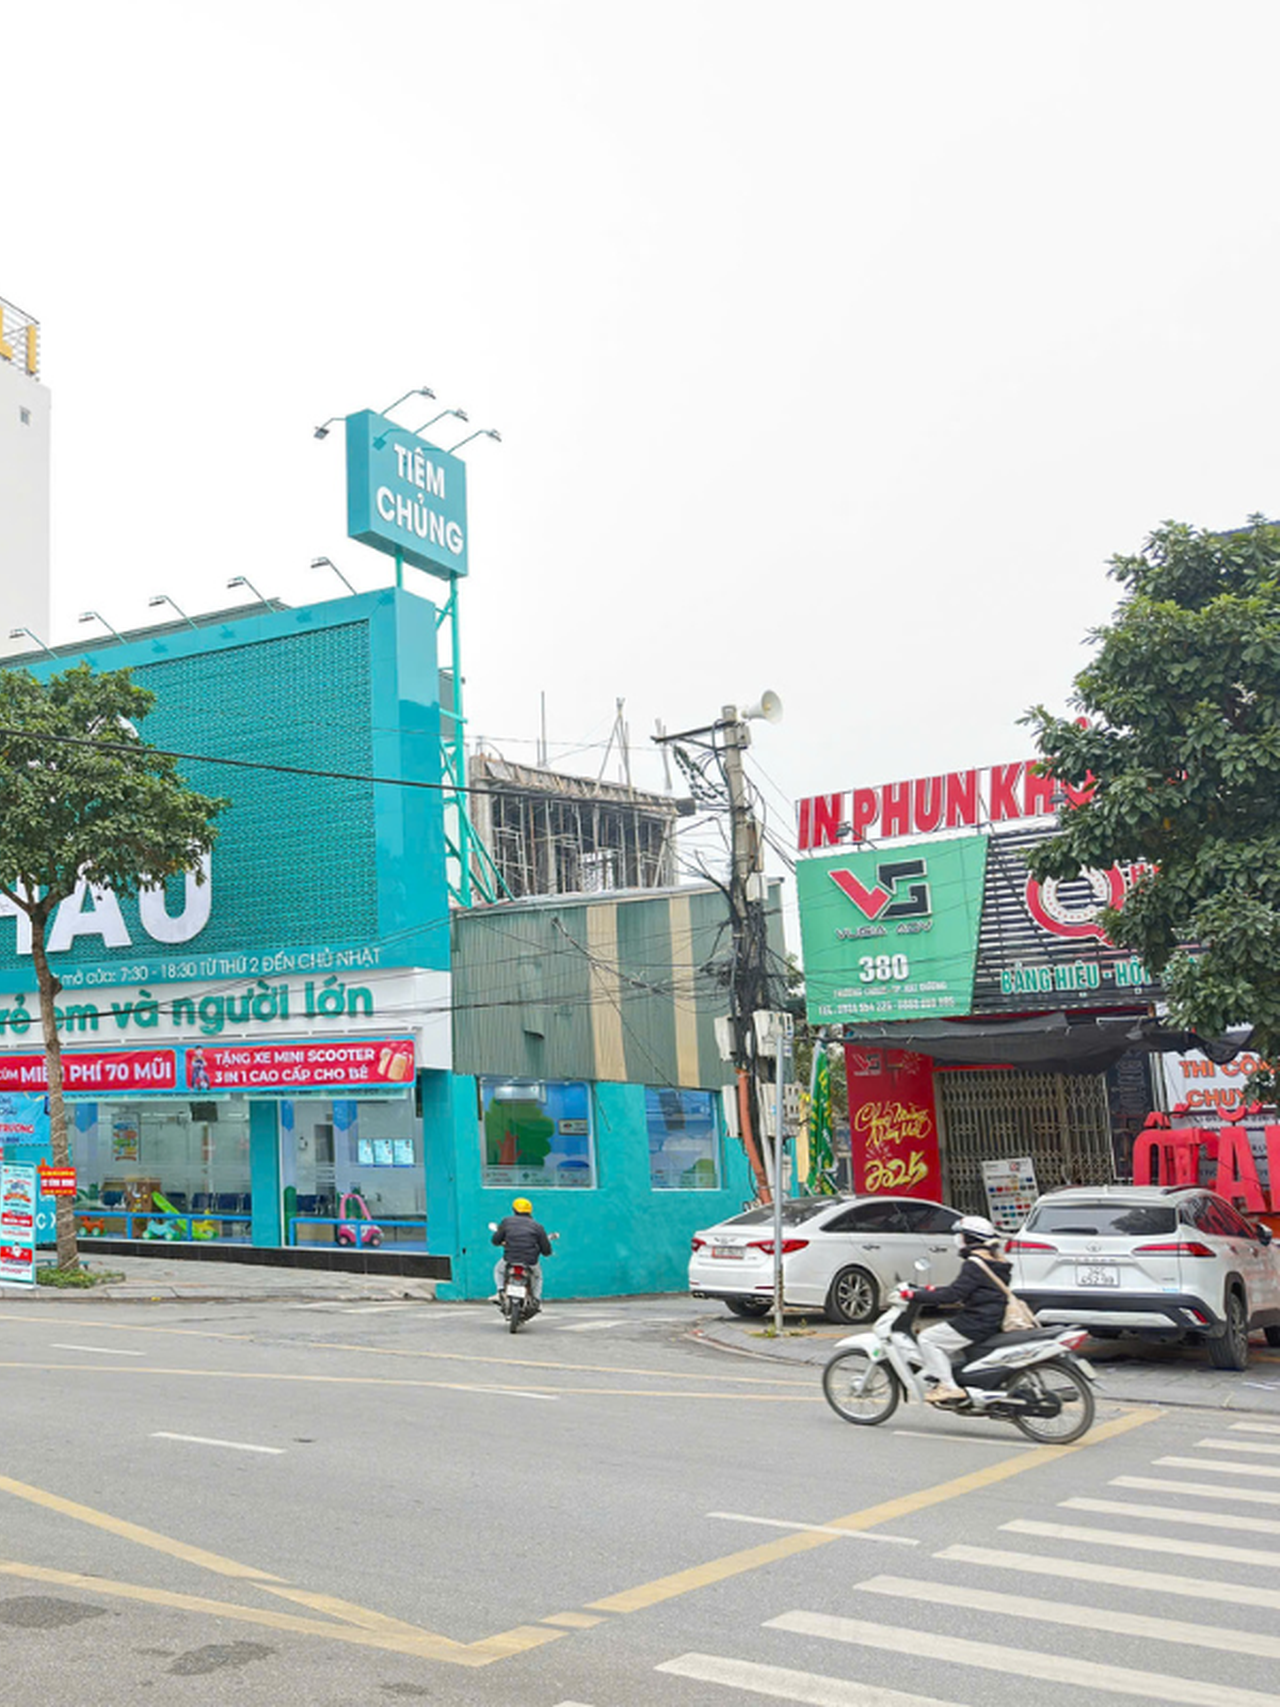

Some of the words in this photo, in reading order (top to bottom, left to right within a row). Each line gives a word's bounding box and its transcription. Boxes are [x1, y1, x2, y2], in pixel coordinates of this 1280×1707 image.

[394, 443, 445, 500] TIÊM
[376, 485, 464, 555] CHỦNG
[798, 792, 845, 850] IN
[852, 768, 979, 842] PHUN
[120, 965, 149, 981] 7:30
[161, 962, 197, 979] 18:30
[250, 957, 258, 972] 2
[858, 953, 910, 983] 380
[111, 990, 160, 1030] và
[172, 979, 290, 1036] người
[305, 974, 375, 1019] lớn
[70, 1059, 101, 1083] PHÍ
[105, 1063, 130, 1082] 70
[134, 1057, 172, 1080] MŨI
[214, 1053, 250, 1069] TẶNG
[253, 1052, 272, 1065] XE
[274, 1050, 305, 1064] MINI
[307, 1048, 375, 1063] SCOOTER
[1179, 1059, 1214, 1079] THI
[214, 1071, 223, 1084] 3
[224, 1071, 239, 1083] IN
[241, 1070, 248, 1083] 1
[249, 1069, 279, 1083] CAO
[282, 1064, 310, 1082] CẤP
[312, 1068, 345, 1081] CHO
[348, 1064, 369, 1080] BÉ
